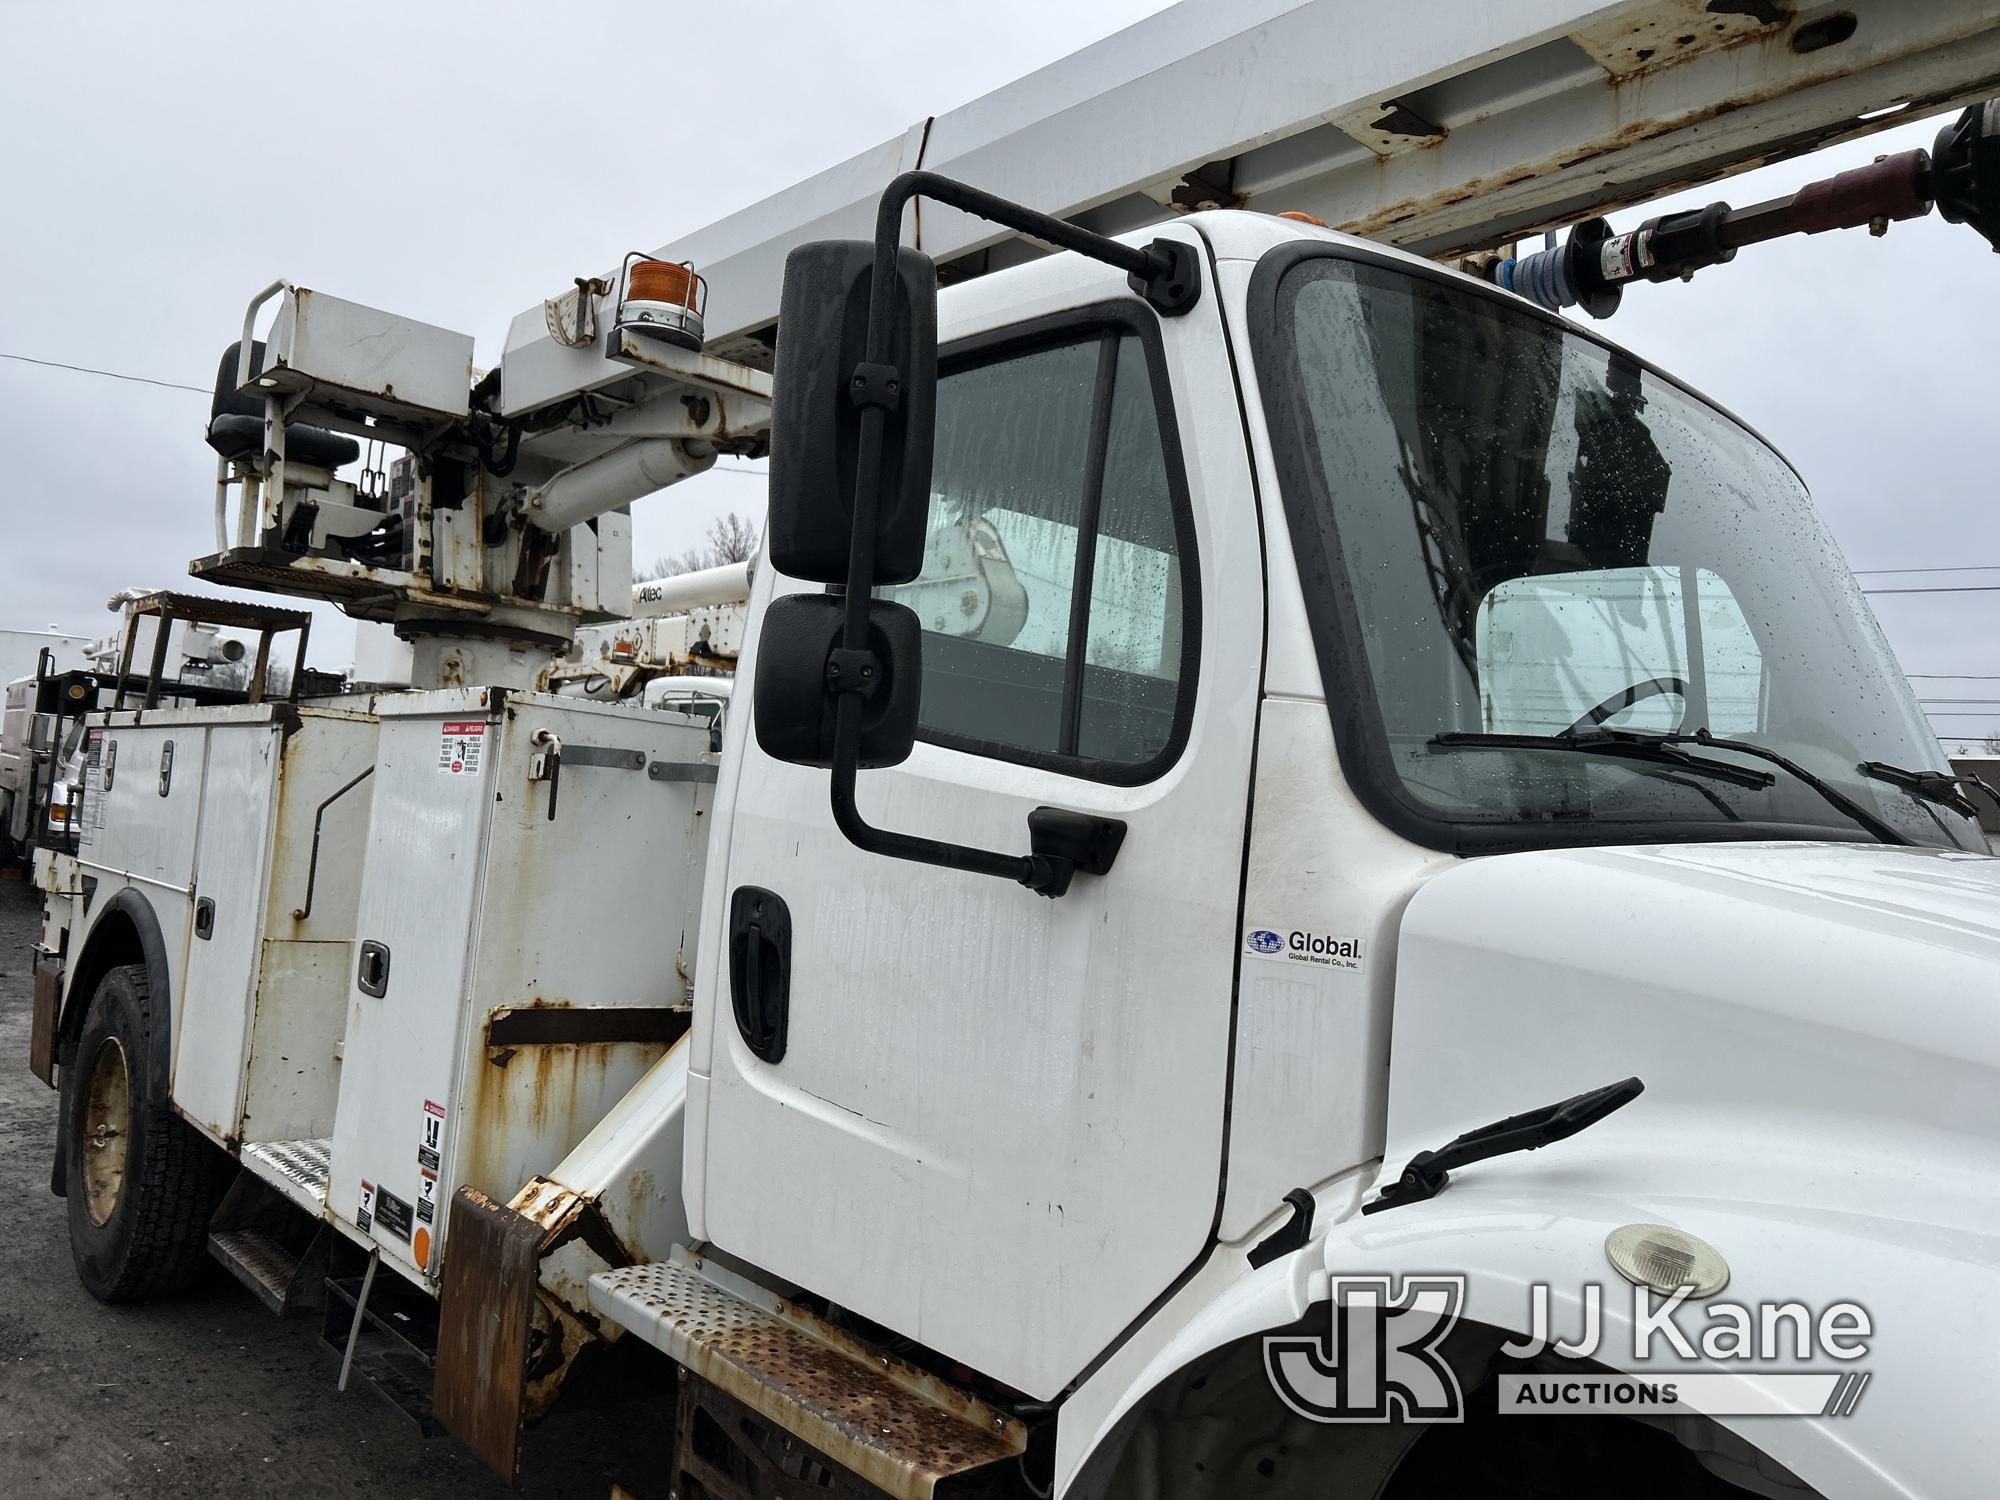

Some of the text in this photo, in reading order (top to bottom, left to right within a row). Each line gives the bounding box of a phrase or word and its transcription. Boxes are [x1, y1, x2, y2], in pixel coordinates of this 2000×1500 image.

[639, 586, 662, 604] Altec
[1289, 931, 1359, 958] Global
[1288, 952, 1309, 962] Global
[1310, 955, 1330, 965] Rental
[1346, 960, 1359, 969] Inc.
